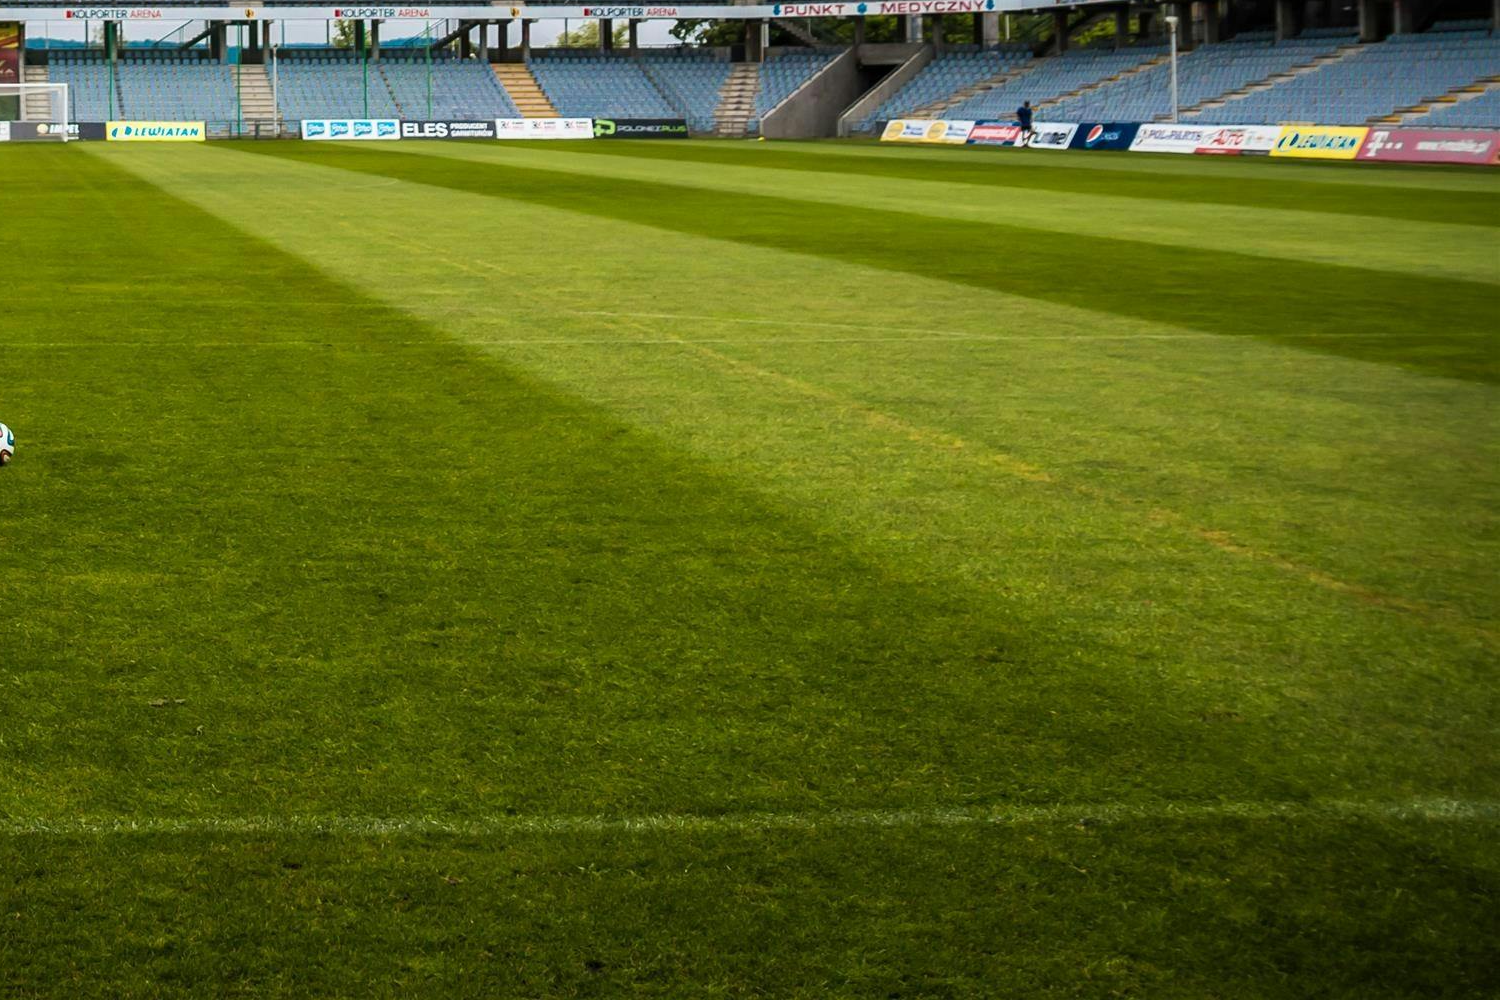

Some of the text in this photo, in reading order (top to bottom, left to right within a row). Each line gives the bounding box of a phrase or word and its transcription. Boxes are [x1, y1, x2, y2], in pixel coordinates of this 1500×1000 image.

[341, 8, 430, 18] KOLPORTER ARENA
[590, 7, 677, 17] KOLPORTER ARENA
[783, 0, 984, 16] PUNKT MEDYCZNY
[73, 9, 161, 19] KOLPORTER ARENA
[402, 122, 449, 138] ELES
[450, 122, 488, 130] PRODUCENT
[134, 127, 199, 137] LEWIATAN
